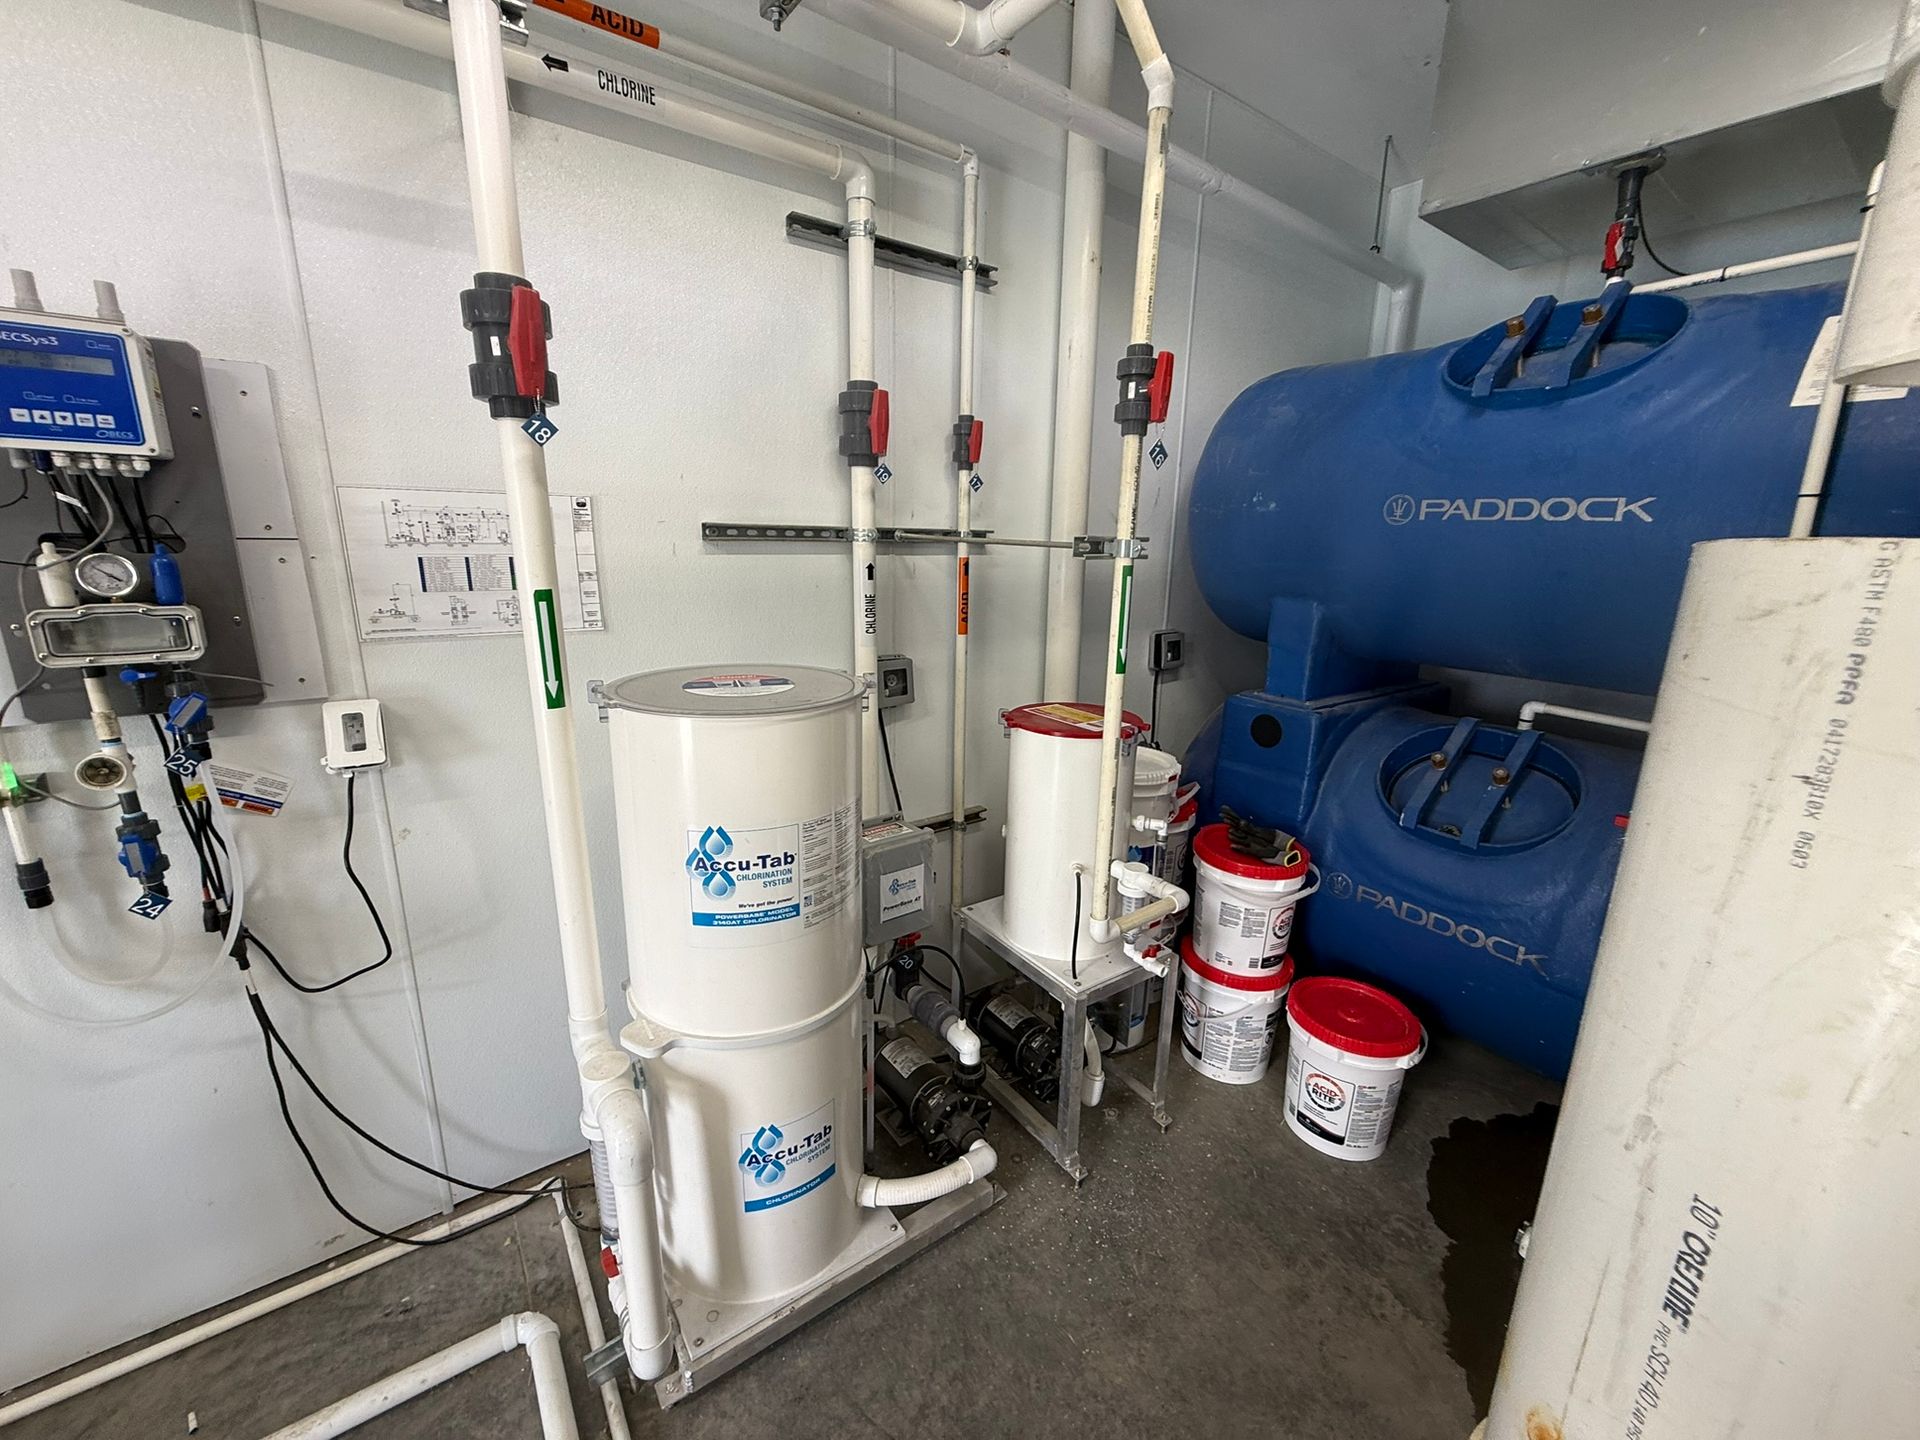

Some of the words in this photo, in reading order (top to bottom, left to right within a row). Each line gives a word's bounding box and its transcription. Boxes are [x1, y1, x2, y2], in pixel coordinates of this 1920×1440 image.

[591, 5, 644, 38] ACID
[598, 70, 656, 106] CHLORINE
[0, 331, 58, 346] ECSys3
[528, 420, 551, 443] 18
[1151, 447, 1165, 468] 16
[876, 468, 889, 482] 19
[971, 477, 981, 489] 17
[1418, 496, 1657, 523] PADDOCK
[1864, 557, 1895, 601] ASTM
[864, 593, 877, 635] CHLORINE
[166, 754, 198, 774] 25
[694, 851, 796, 872] Accu-Tab
[736, 868, 793, 882] CHLORINATION
[762, 877, 793, 888] SYSTEM
[131, 898, 164, 917] 24
[742, 911, 797, 925] CHLORINATOR
[767, 907, 794, 916] MODEL
[1356, 884, 1550, 981] PADDOCK
[899, 955, 914, 969] 20
[1312, 1087, 1335, 1104] RITE
[1313, 1082, 1339, 1097] ACID
[746, 1124, 832, 1167] Accu-Tab
[785, 1136, 831, 1166] CHLORINATION
[807, 1144, 831, 1163] SYSTEM
[765, 1177, 821, 1206] CHLORINATOR
[1689, 1193, 1723, 1240] 10"
[1653, 1319, 1671, 1348] PVC
[1643, 1345, 1670, 1387] SCH
[1637, 1380, 1660, 1408] 40
